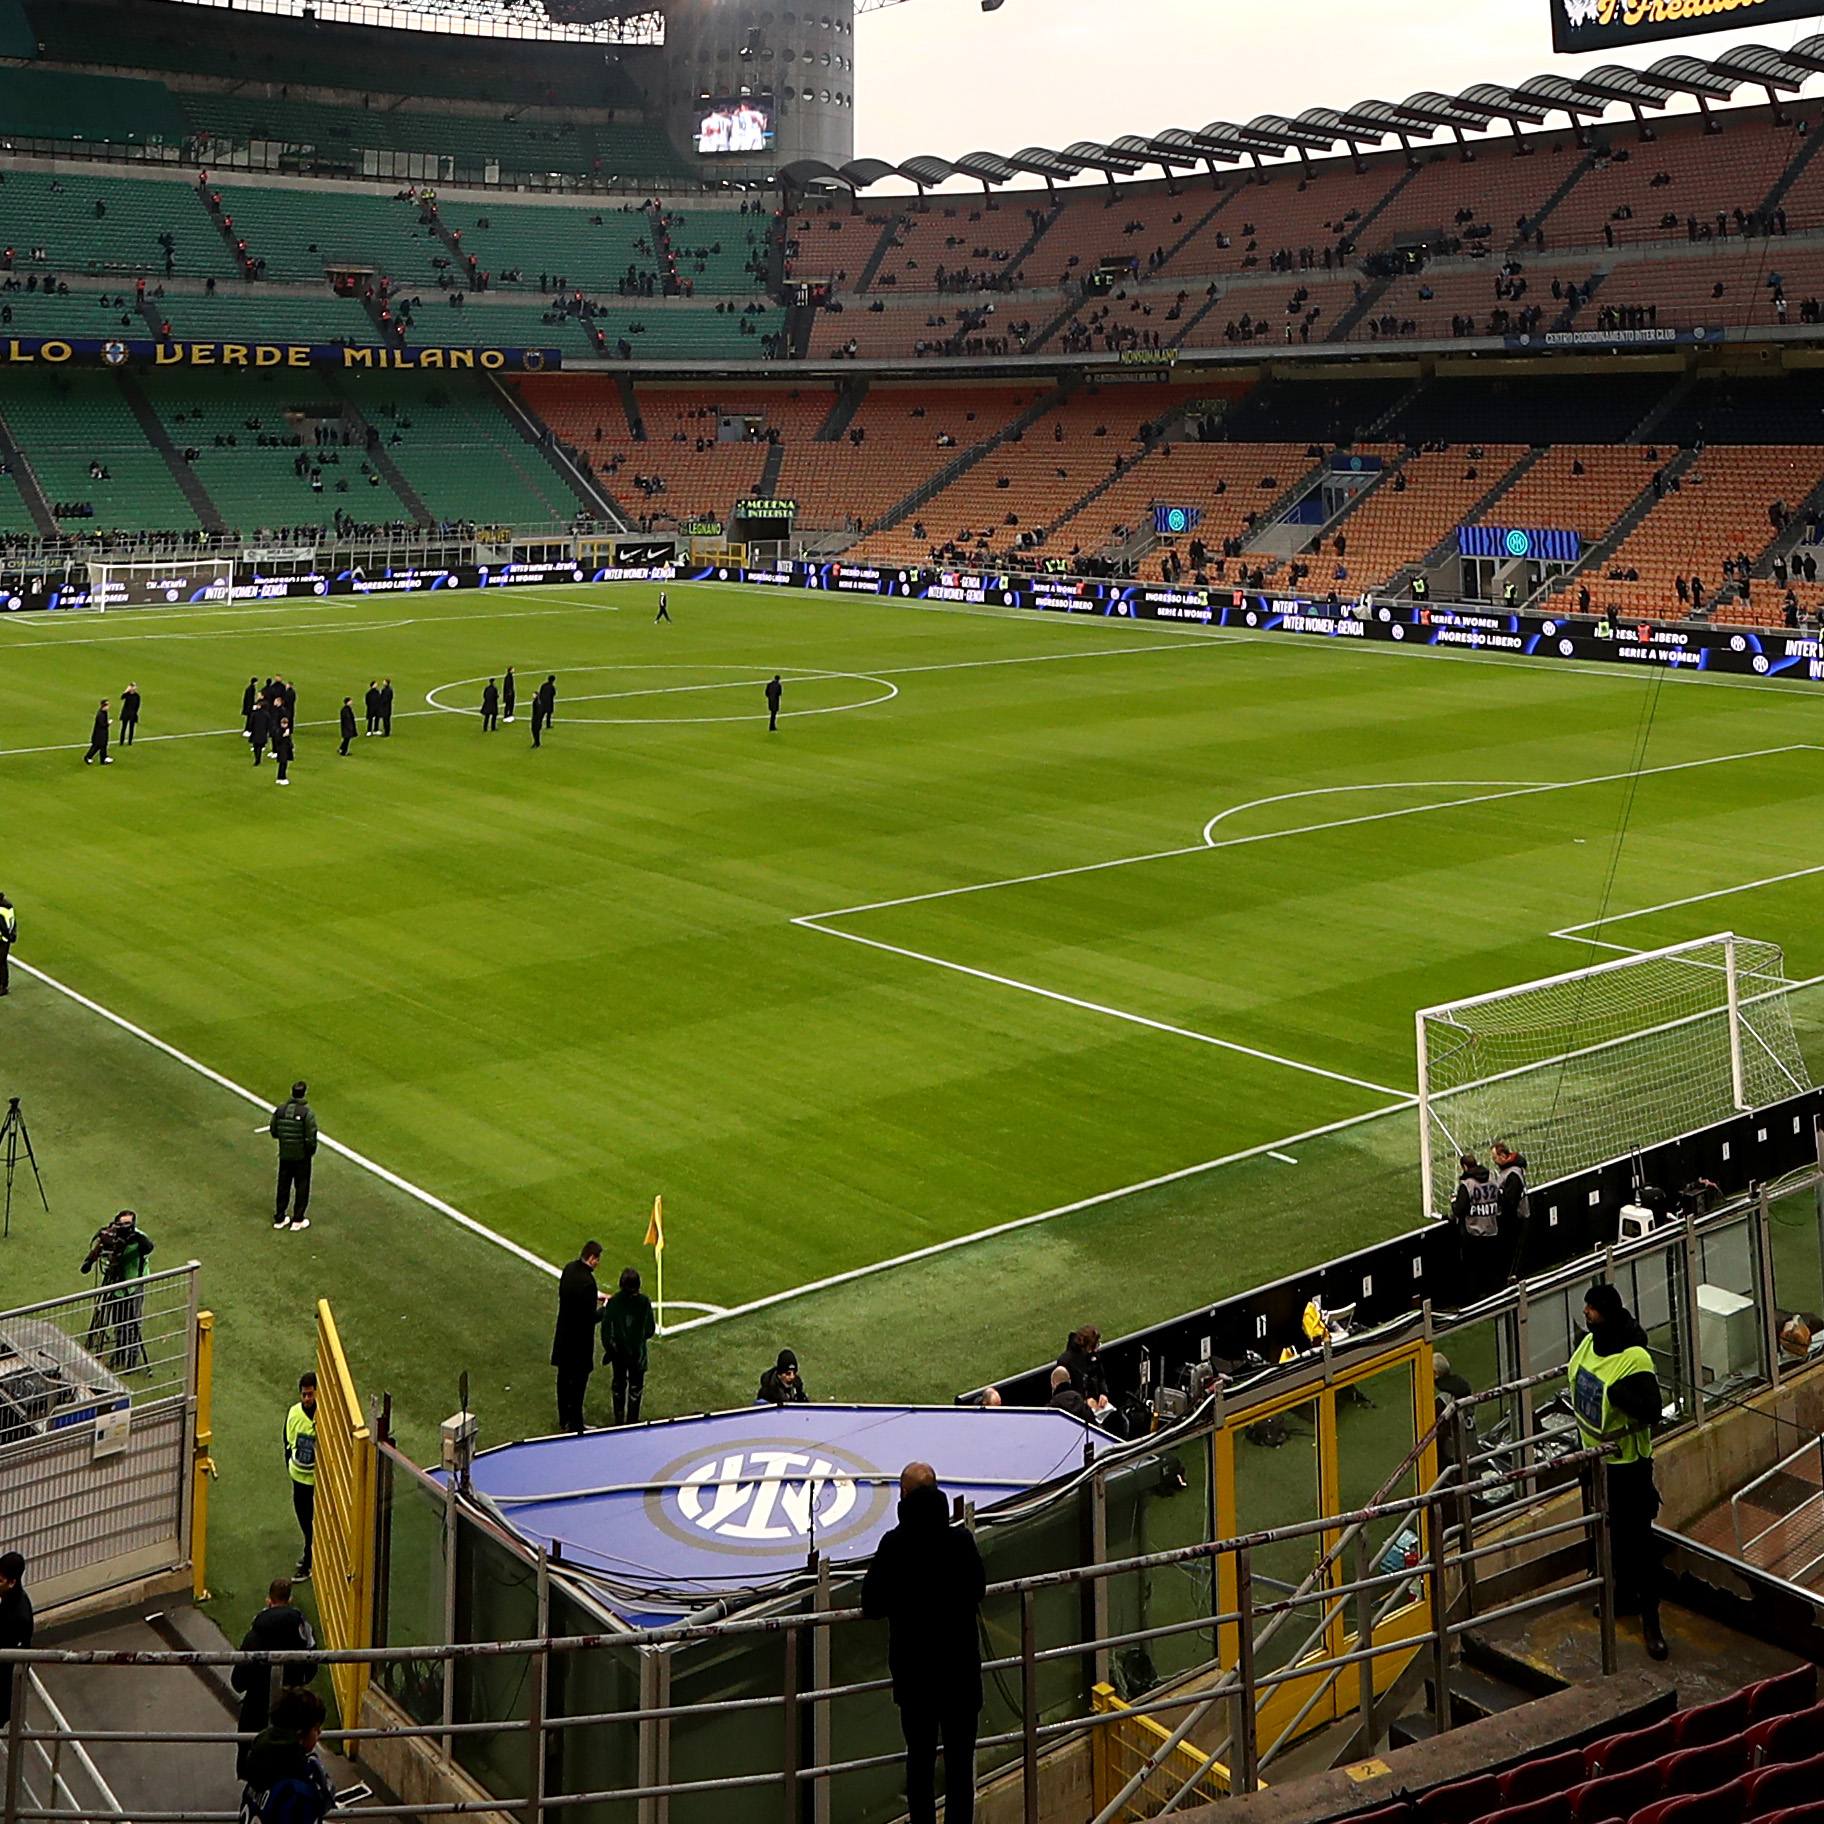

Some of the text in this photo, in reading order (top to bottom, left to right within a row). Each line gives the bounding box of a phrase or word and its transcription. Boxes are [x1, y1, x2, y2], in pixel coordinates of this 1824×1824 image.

[1656, 328, 1676, 341] CLUB
[343, 347, 505, 369] MILANO
[747, 500, 795, 509] MODENA
[689, 522, 721, 535] LEGNANO
[1056, 585, 1077, 595] WOME
[1035, 597, 1093, 610] INGRESSO LIBERO
[1145, 592, 1181, 604] INGRESSO
[1157, 607, 1212, 620] SERIE A WOMEN
[1272, 600, 1293, 614] INTER
[1283, 615, 1304, 631] INTER
[1305, 617, 1335, 633] WOMEN
[1338, 620, 1364, 636] GENOA
[1430, 614, 1499, 629] SERIE A WOMEN
[1438, 630, 1522, 648] INGRESSO LIBERO
[1619, 647, 1700, 663] SERIE A WOMEN
[1785, 639, 1818, 658] INTER
